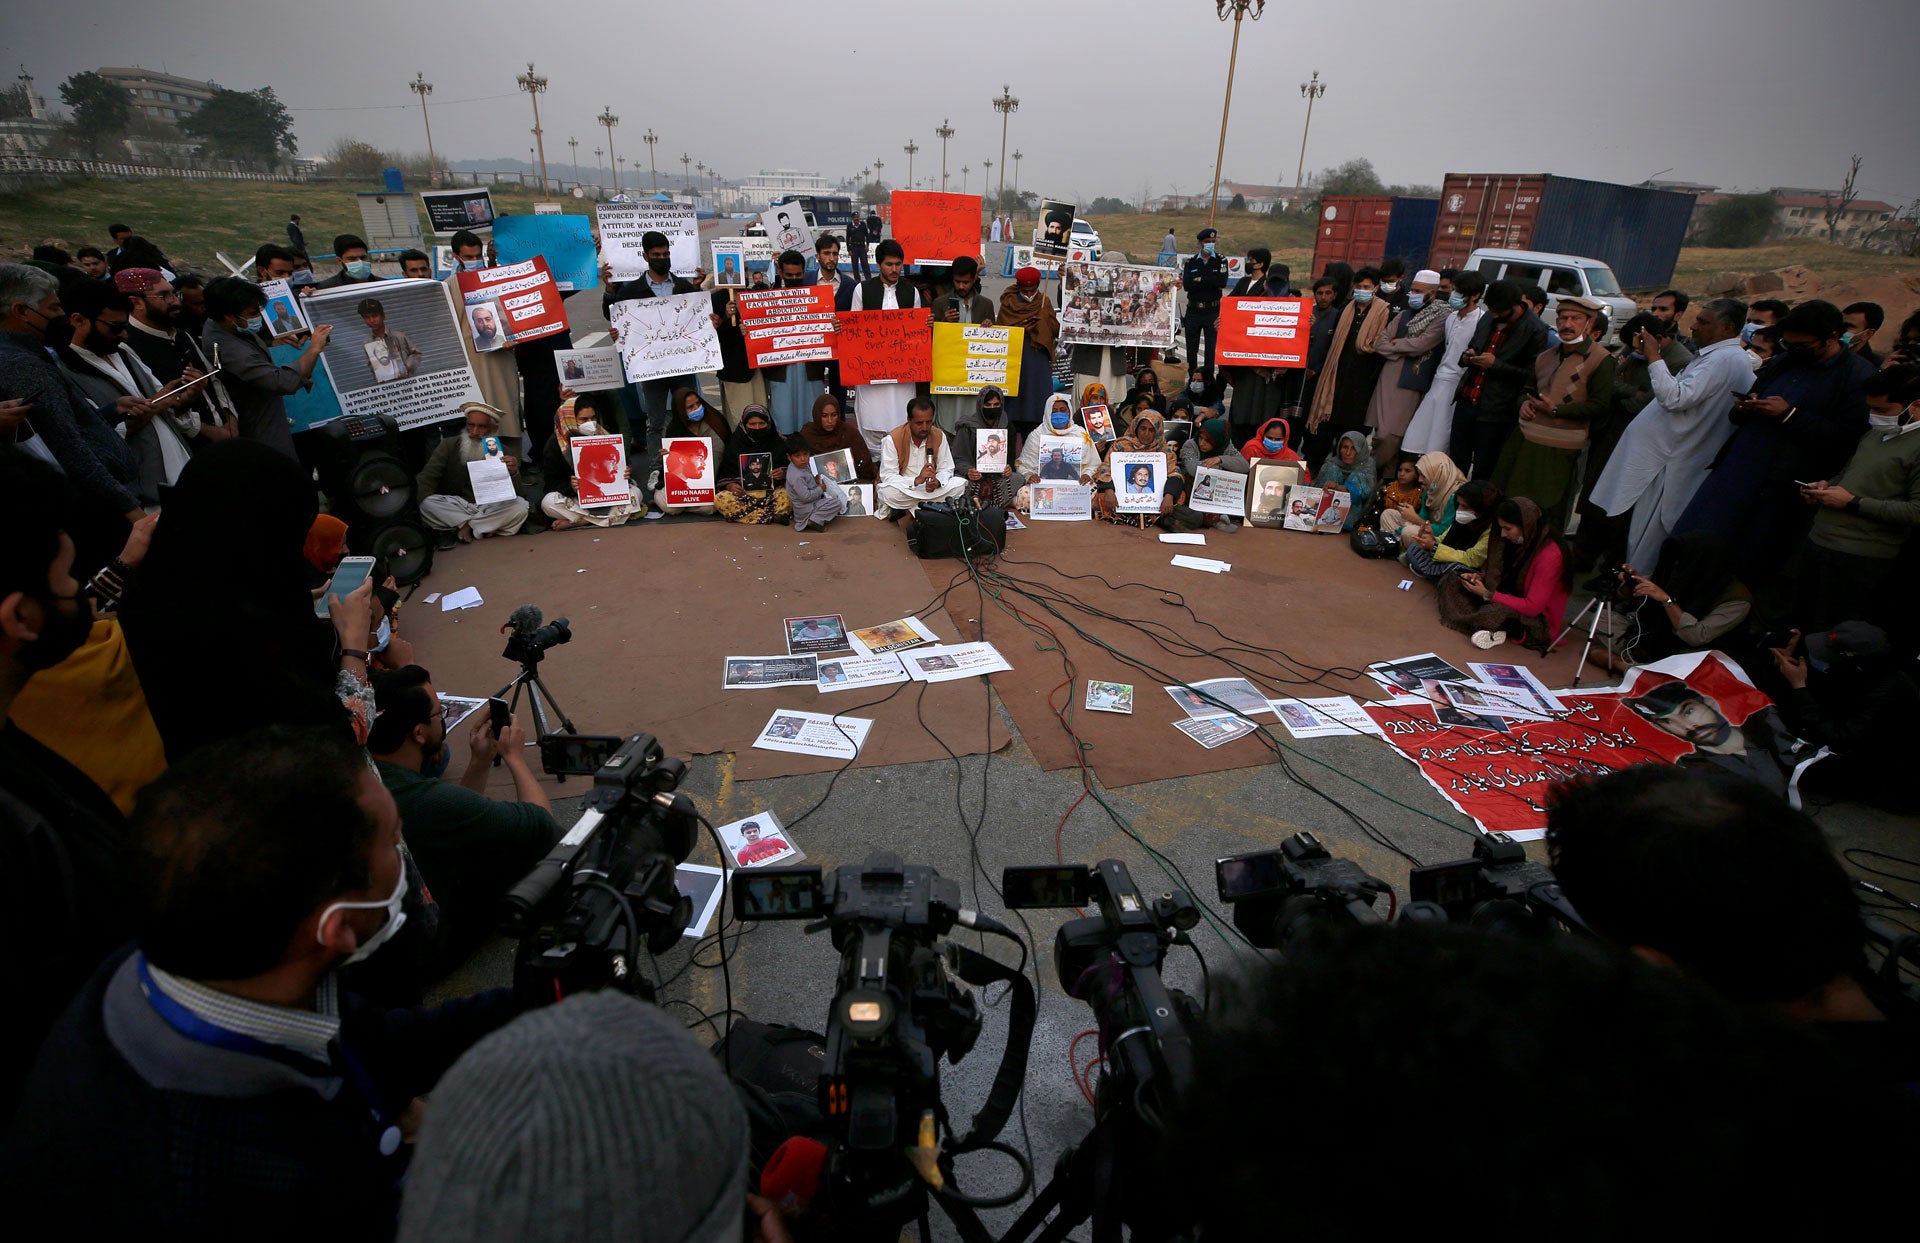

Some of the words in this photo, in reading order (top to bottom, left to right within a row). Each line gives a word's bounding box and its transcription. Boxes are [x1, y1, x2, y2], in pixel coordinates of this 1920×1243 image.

[767, 306, 806, 315] ABDUCTION?
[865, 328, 875, 338] to
[865, 341, 885, 350] ever
[1224, 352, 1299, 360] #ReleaseBalochMissingPersons
[632, 364, 715, 380] #ReleaseBalochMissingPersons
[349, 390, 369, 399] SPENT
[382, 380, 417, 391] CHILDHOOD
[354, 395, 386, 406] PROTESTS
[432, 379, 461, 388] RELEASE
[375, 407, 392, 415] ALSO
[399, 401, 420, 410] VICTIM
[430, 391, 465, 403] ENFORCED
[390, 395, 413, 404] FATHER
[582, 495, 628, 504] #FINDNAARUALIVE
[874, 638, 921, 653] BALOCHISTAN
[1385, 719, 1438, 735] 2013
[764, 738, 850, 751] #ReleaseBalochMissingPersons
